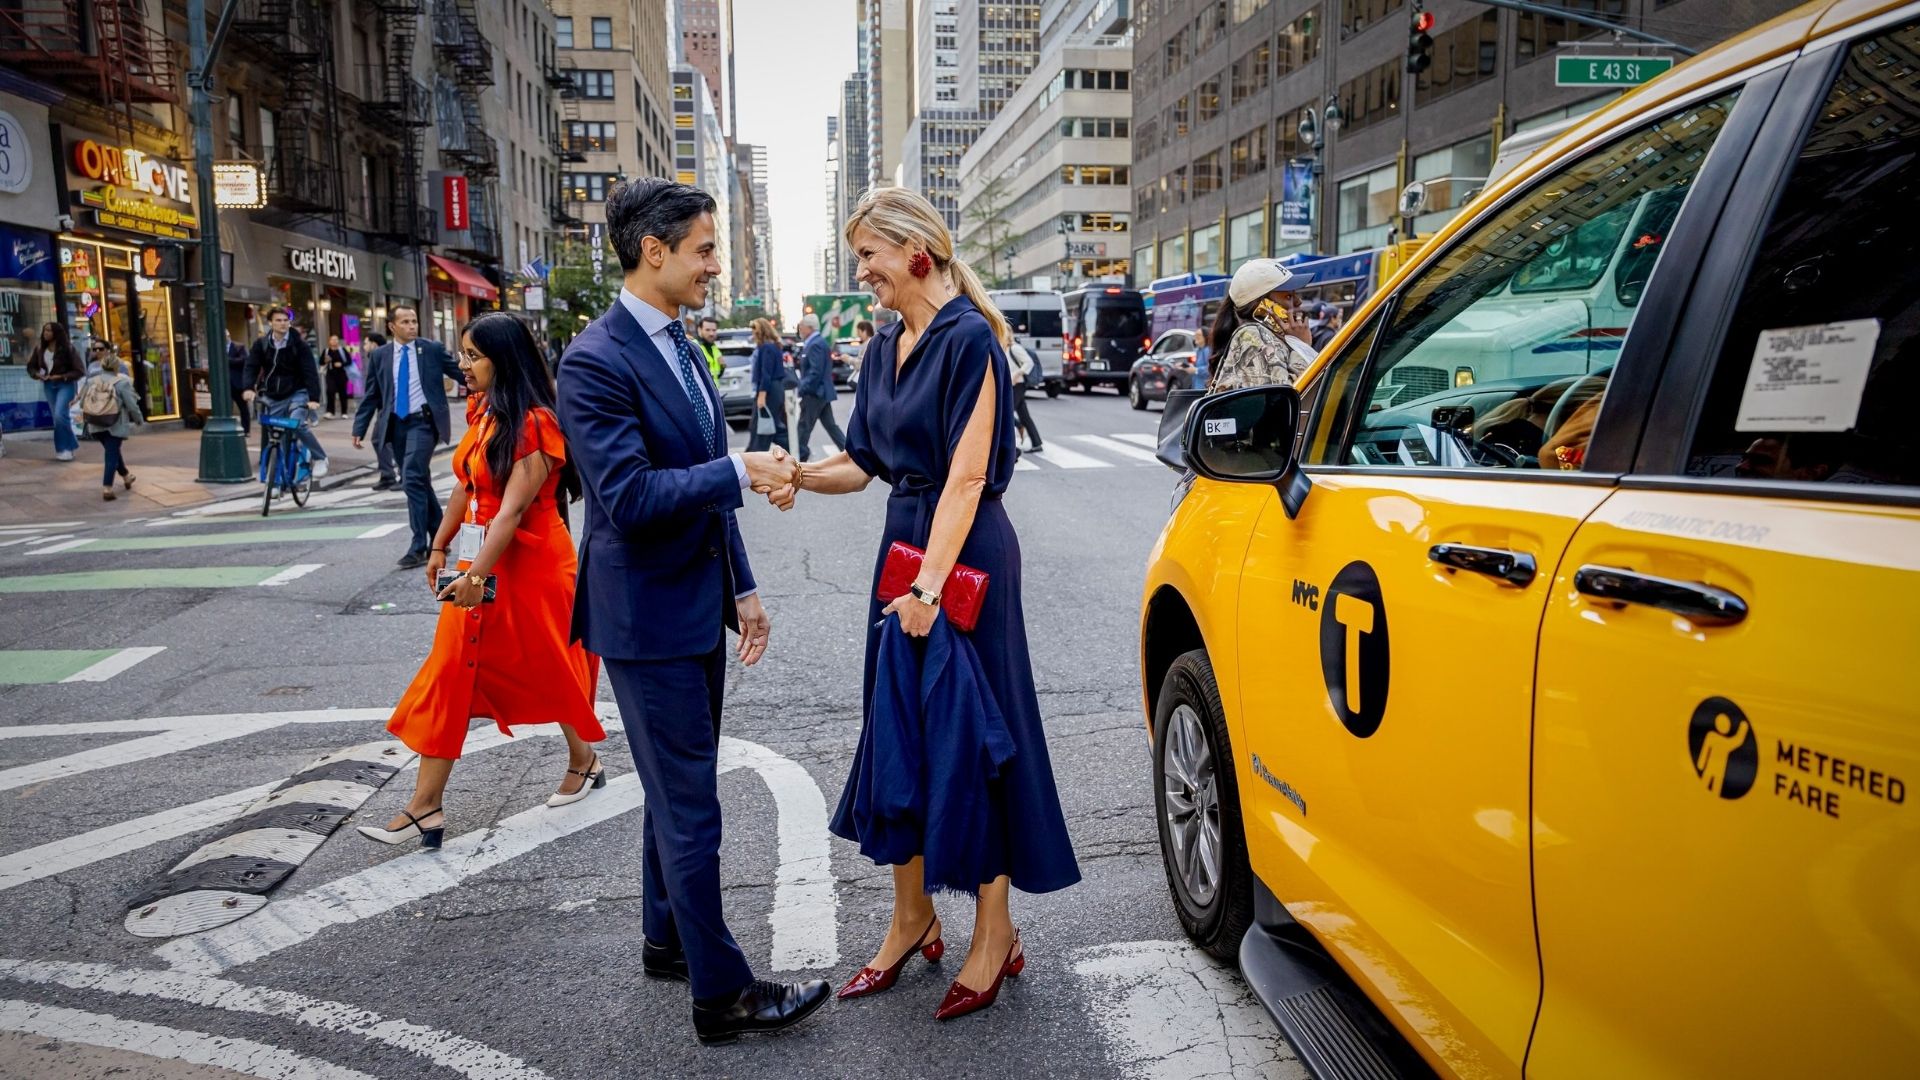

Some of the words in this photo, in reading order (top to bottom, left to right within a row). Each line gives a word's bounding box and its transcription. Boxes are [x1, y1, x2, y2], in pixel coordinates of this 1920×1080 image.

[1589, 63, 1598, 80] E
[1603, 63, 1621, 80] 43
[1626, 63, 1641, 80] St
[315, 246, 357, 281] HESTIA
[1067, 243, 1095, 254] PARK
[1207, 422, 1221, 433] BK
[1621, 510, 1714, 535] AUTOMATIC
[1711, 521, 1771, 543] DOOR
[1292, 579, 1319, 611] NYC
[1335, 593, 1374, 714] T
[1777, 740, 1905, 805] METERED
[1775, 773, 1839, 819] FARE
